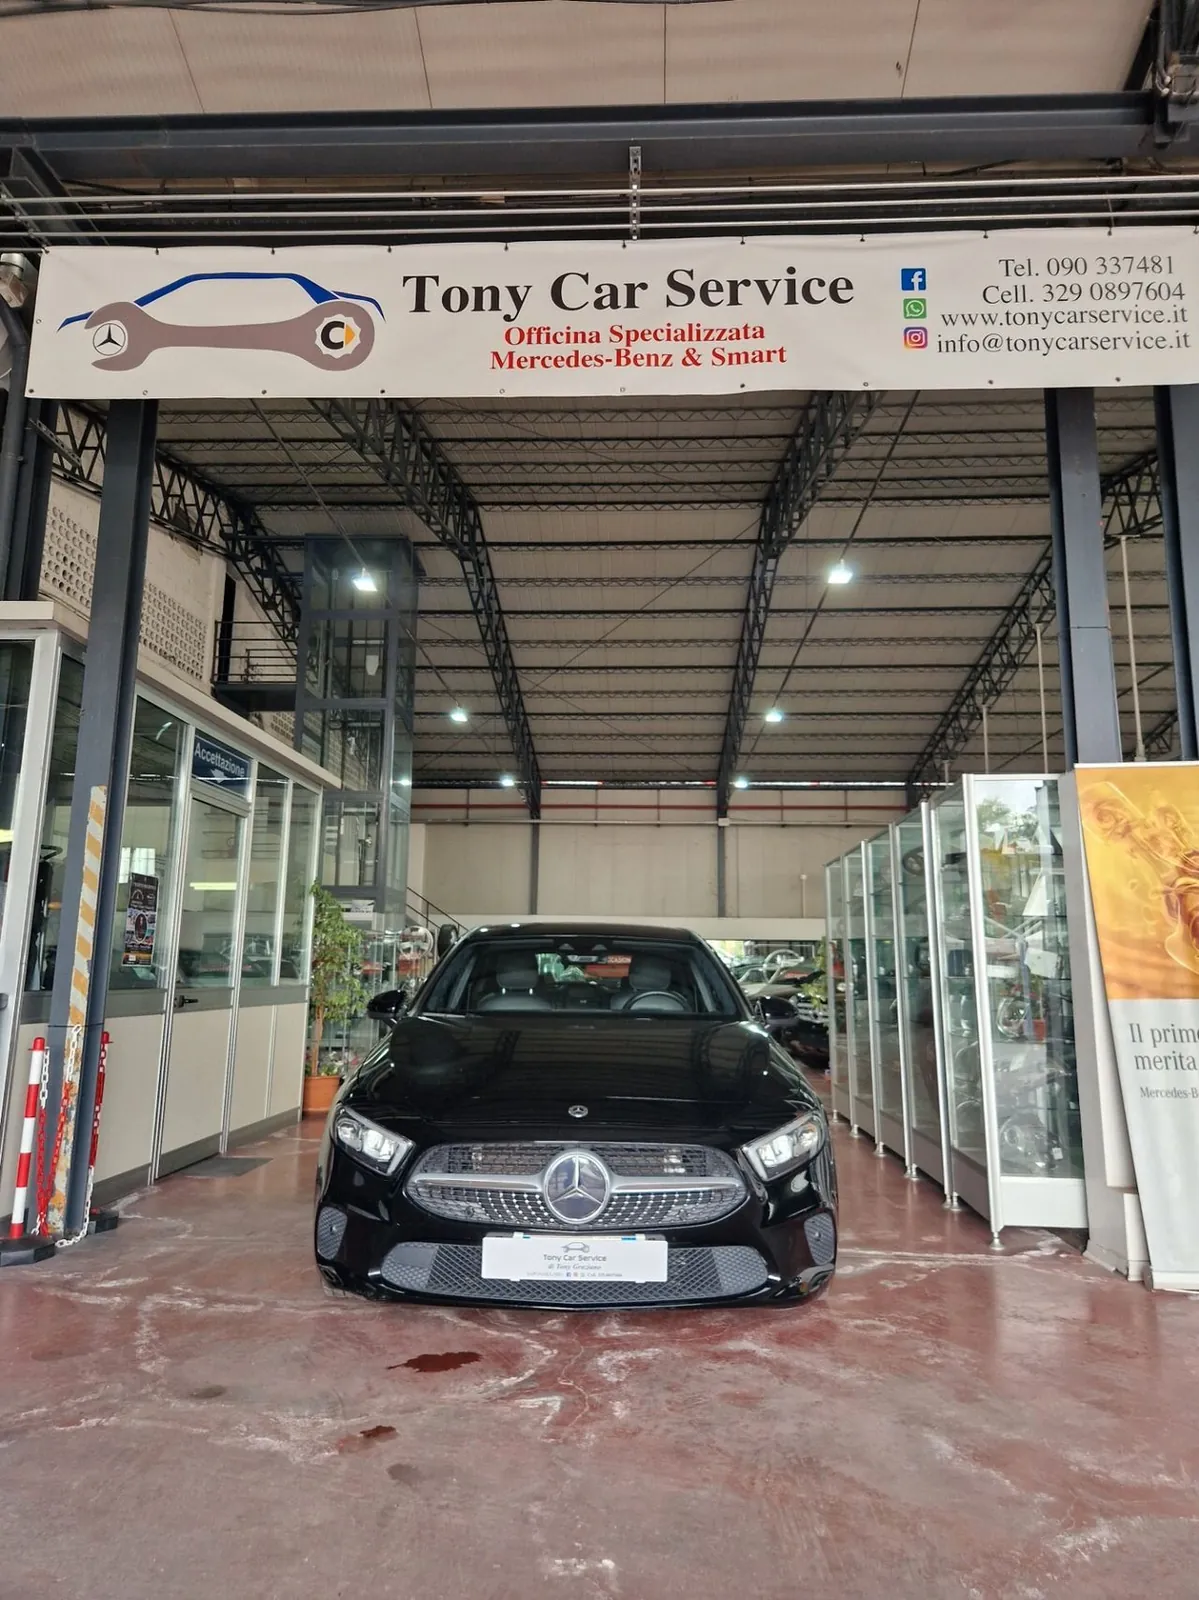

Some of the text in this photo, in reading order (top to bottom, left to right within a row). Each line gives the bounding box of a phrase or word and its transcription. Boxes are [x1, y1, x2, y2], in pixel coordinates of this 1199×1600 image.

[998, 255, 1174, 277] Tel. 090 337481
[402, 266, 855, 322] Tony Car Service
[982, 281, 1186, 304] Cell. 329 0897604
[940, 304, 1189, 330] www.tonycarservice.it
[503, 322, 766, 346] Officina Specializzata
[937, 329, 1192, 356] info@tonycarservice.it
[489, 345, 788, 371] Mercedes-Benz & Smart
[194, 742, 245, 778] Accettazione
[1150, 1024, 1199, 1048] prim
[1134, 1051, 1199, 1071] merita
[1140, 1086, 1199, 1099] Mercedes-B
[543, 1254, 561, 1262] Tony
[578, 1254, 607, 1262] Service
